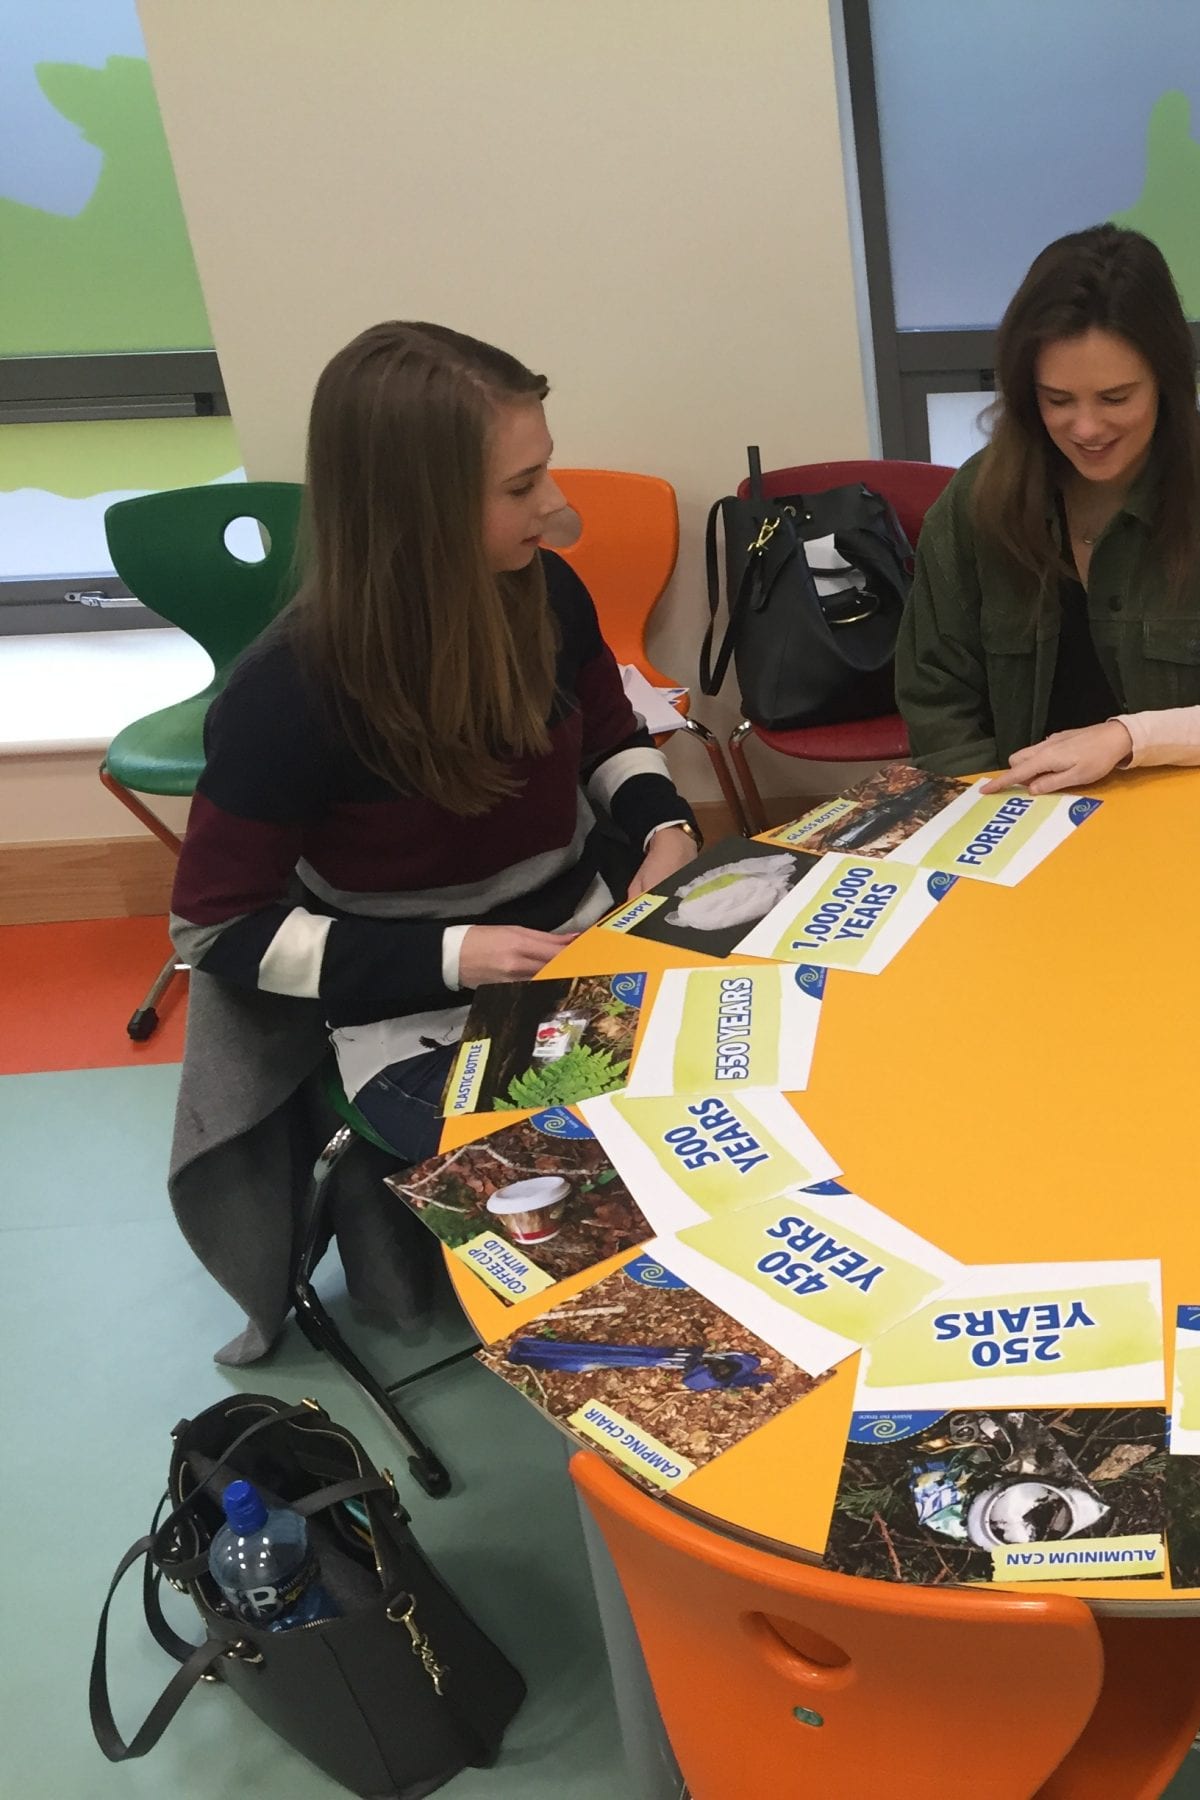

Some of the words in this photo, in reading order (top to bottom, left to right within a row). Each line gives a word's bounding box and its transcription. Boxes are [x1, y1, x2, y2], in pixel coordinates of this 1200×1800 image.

[786, 822, 819, 841] GLASS
[815, 802, 850, 823] BOTTLE
[957, 796, 1034, 867] FOREVER
[612, 899, 653, 929] NAPPY
[791, 866, 875, 951] 1,000,000
[834, 883, 898, 942] YEARS
[717, 977, 753, 1041] YEARS
[463, 1044, 483, 1074] BOTTLE
[715, 1041, 750, 1080] 550
[454, 1075, 474, 1109] PLASTIC
[664, 1126, 720, 1170] 500
[688, 1097, 769, 1174] YEARS
[468, 1249, 493, 1265] CUP
[484, 1240, 505, 1256] LID
[498, 1252, 529, 1277] WITH
[766, 1215, 885, 1292] YEARS
[486, 1262, 527, 1294] COFFEE
[757, 1251, 830, 1294] 450
[933, 1301, 1095, 1341] YEARS
[971, 1335, 1062, 1367] 250
[584, 1408, 625, 1438] CHAIR
[620, 1434, 681, 1479] CAMPING
[1006, 1551, 1044, 1566] CAN
[1048, 1548, 1157, 1565] ALUMINIUM
